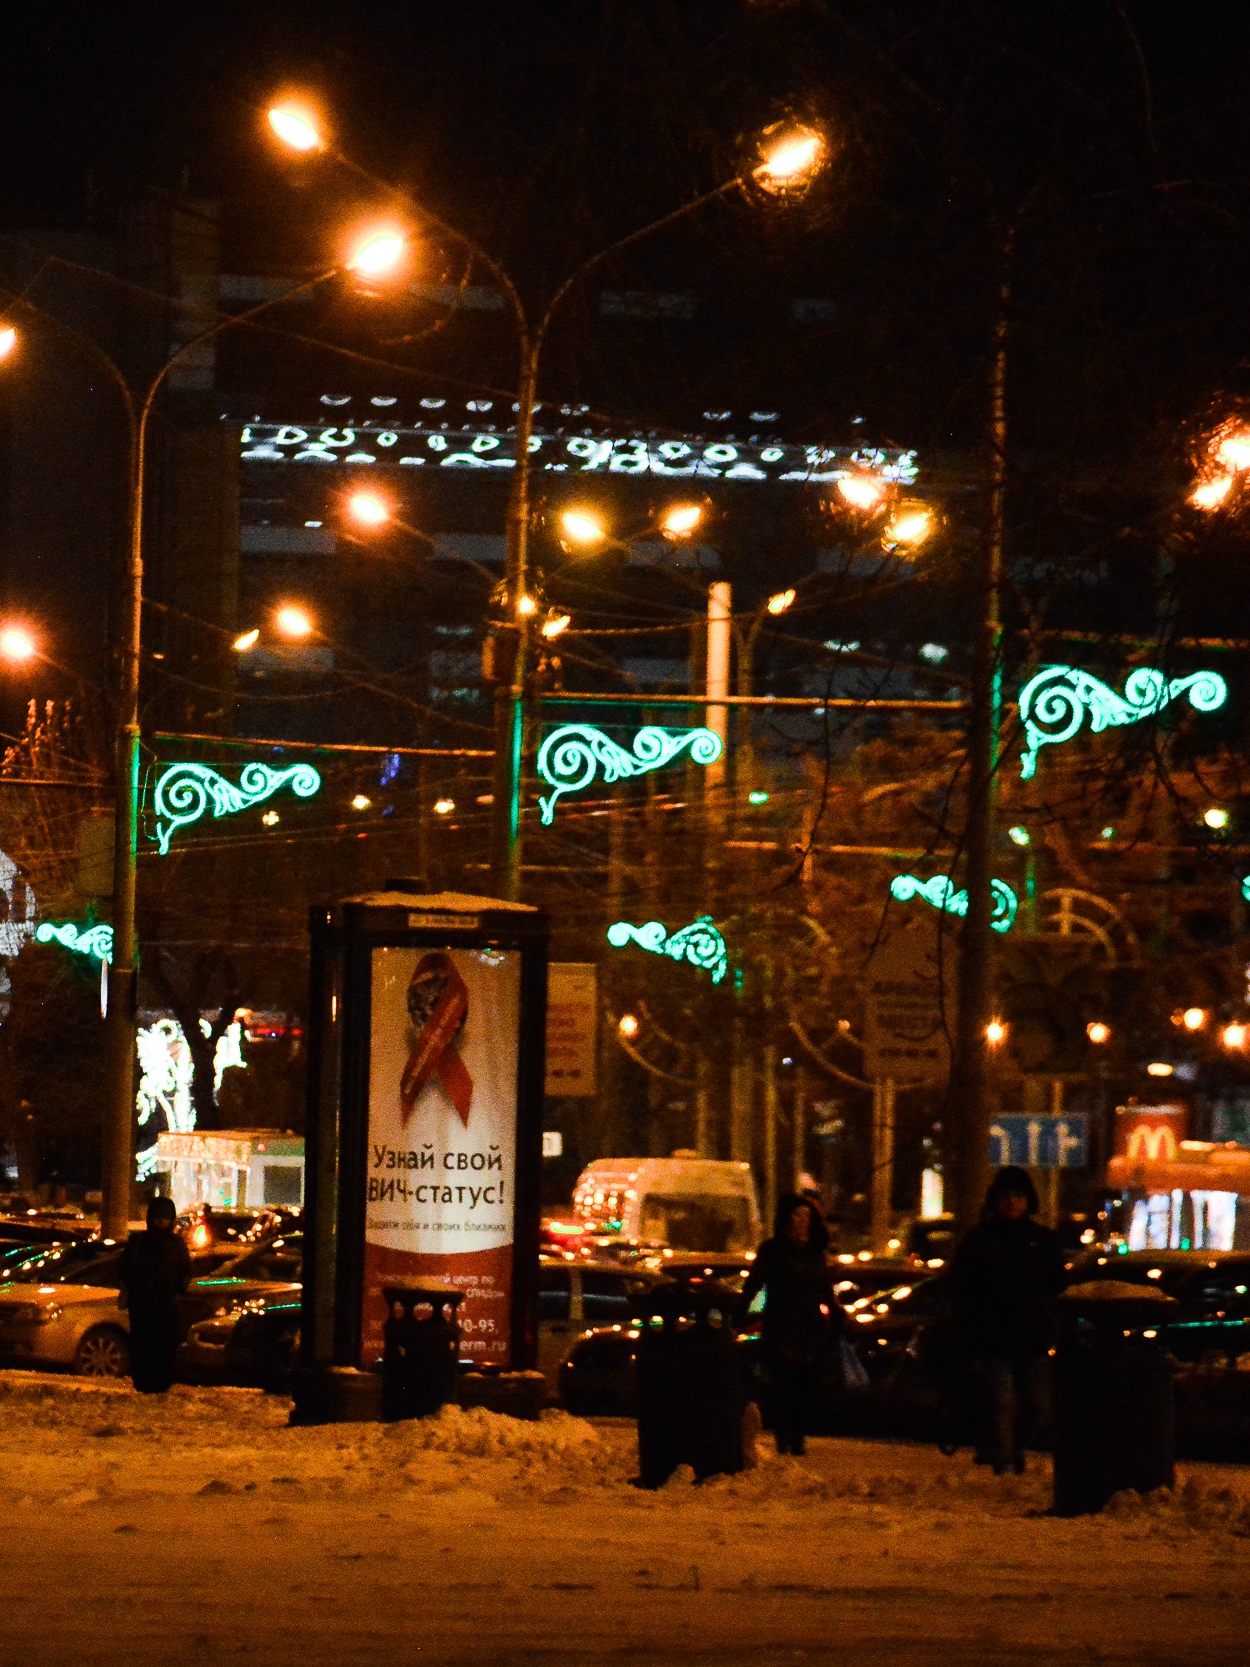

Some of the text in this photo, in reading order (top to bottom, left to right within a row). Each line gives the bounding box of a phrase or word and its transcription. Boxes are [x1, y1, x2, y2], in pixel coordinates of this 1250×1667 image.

[373, 1143, 503, 1171] Узнай свой
[368, 1176, 505, 1210] ВИЧ-статус!
